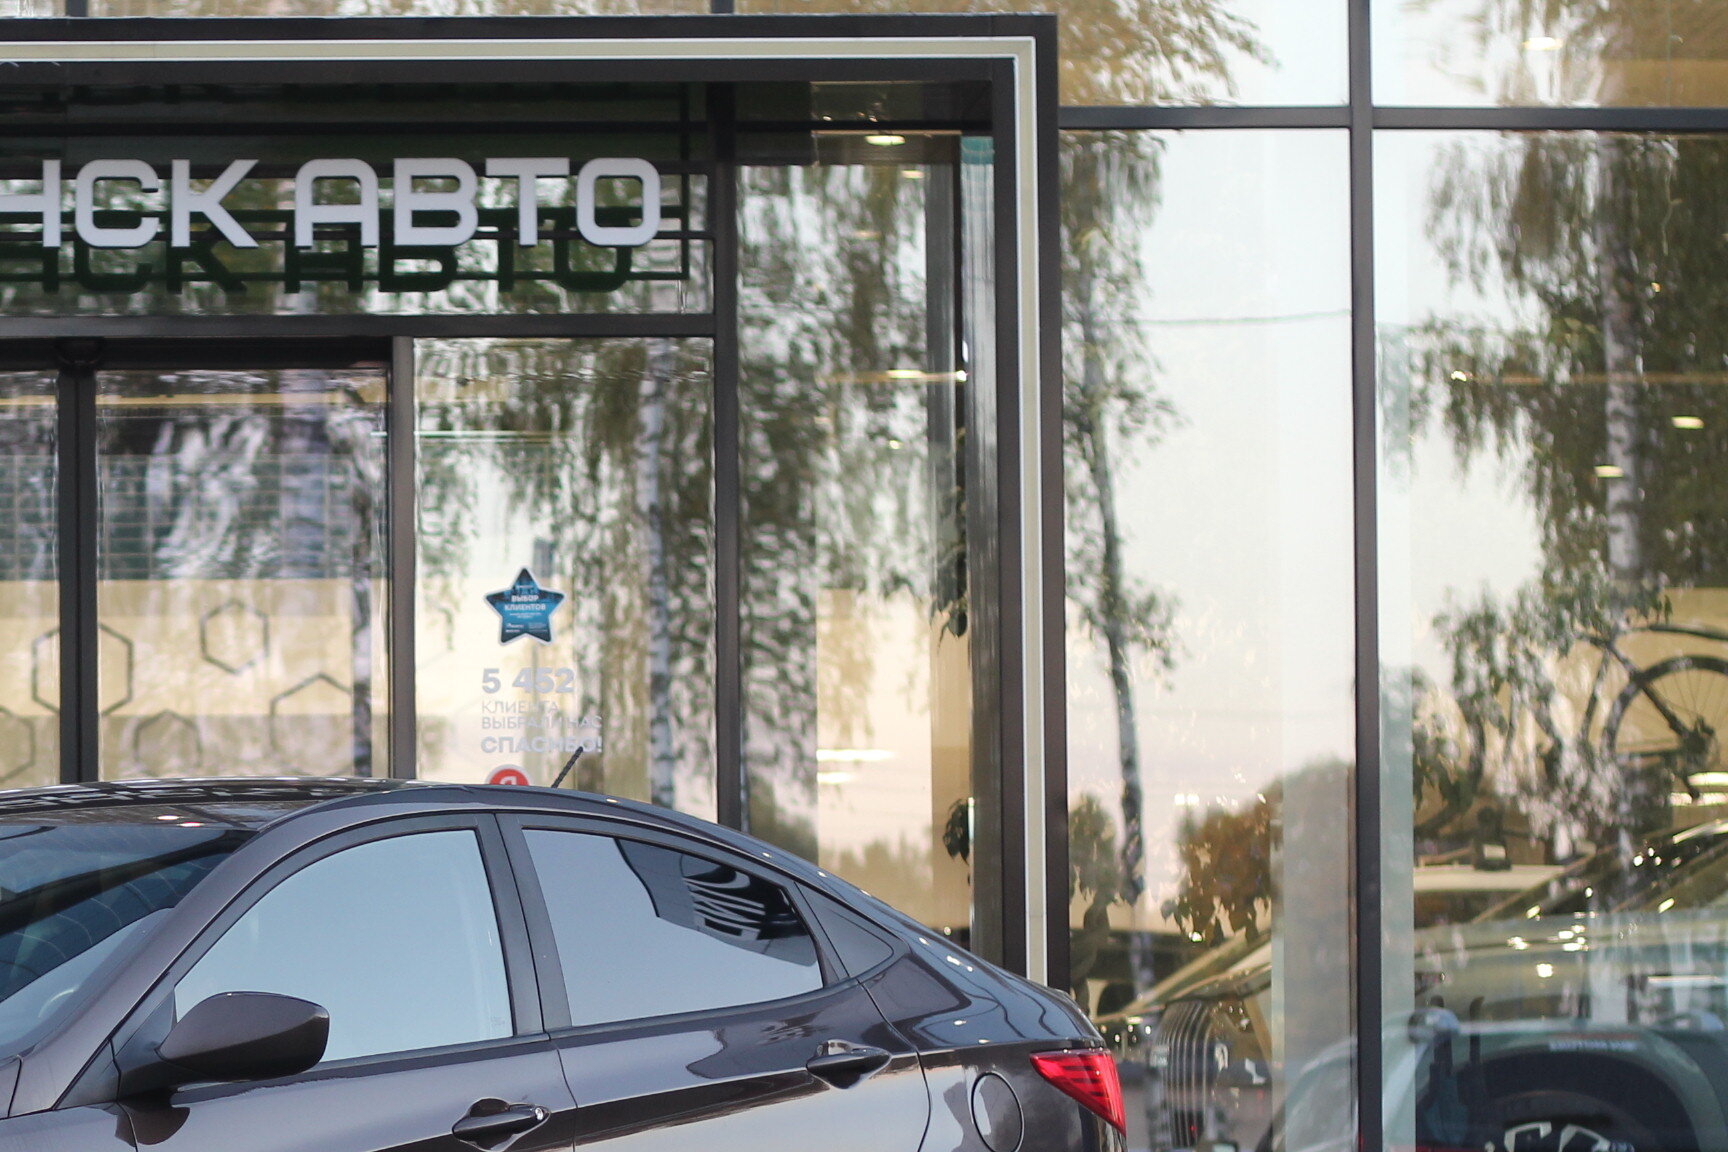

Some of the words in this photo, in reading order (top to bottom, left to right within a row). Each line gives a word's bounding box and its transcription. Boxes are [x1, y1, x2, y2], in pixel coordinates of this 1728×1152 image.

[293, 156, 661, 248] АВТО
[482, 668, 501, 694] 5
[512, 667, 575, 694] 452
[480, 736, 603, 753] СПАСИБО!
